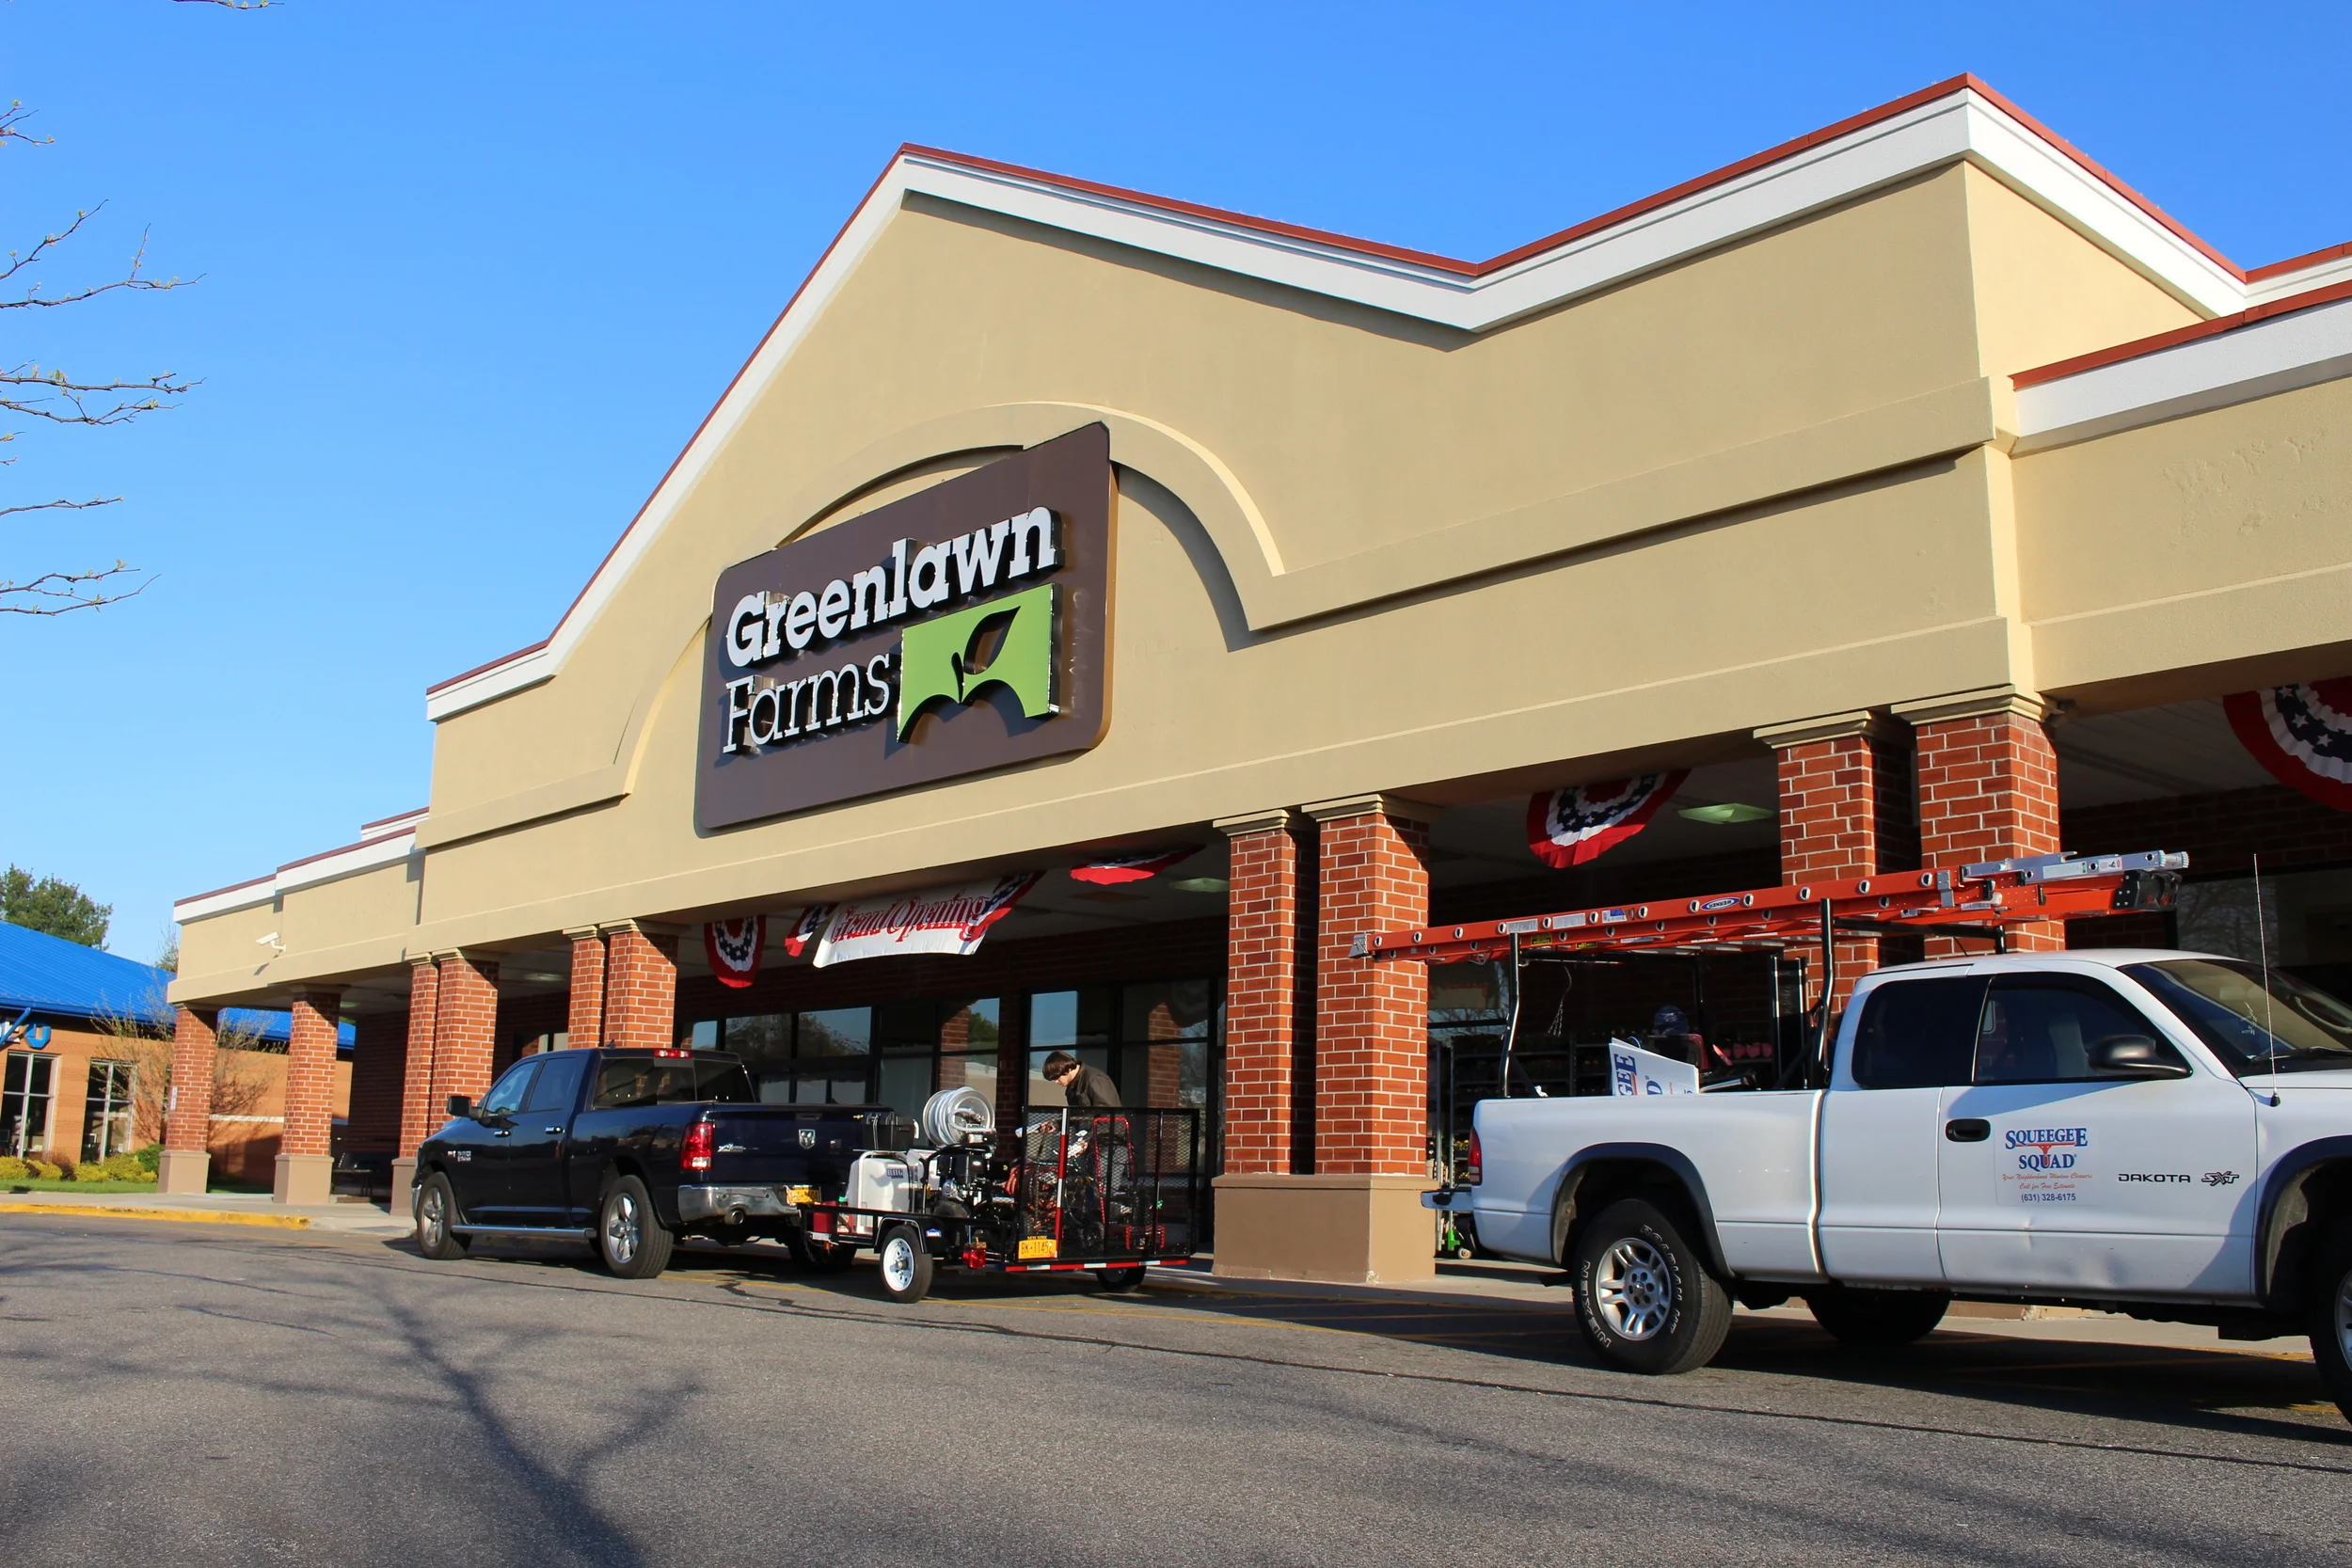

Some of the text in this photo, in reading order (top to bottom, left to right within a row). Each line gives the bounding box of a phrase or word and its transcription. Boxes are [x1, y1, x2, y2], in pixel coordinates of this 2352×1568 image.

[726, 506, 1059, 667] Greenlawn
[723, 652, 892, 754] Farms
[830, 889, 990, 943] Grand Opening
[2005, 1128, 2088, 1149] SQUEEGEE
[2021, 1193, 2076, 1203] (631) 328-6175
[2118, 1171, 2240, 1186] DAKOTA SXT
[1581, 1259, 1613, 1348] NEXEN
